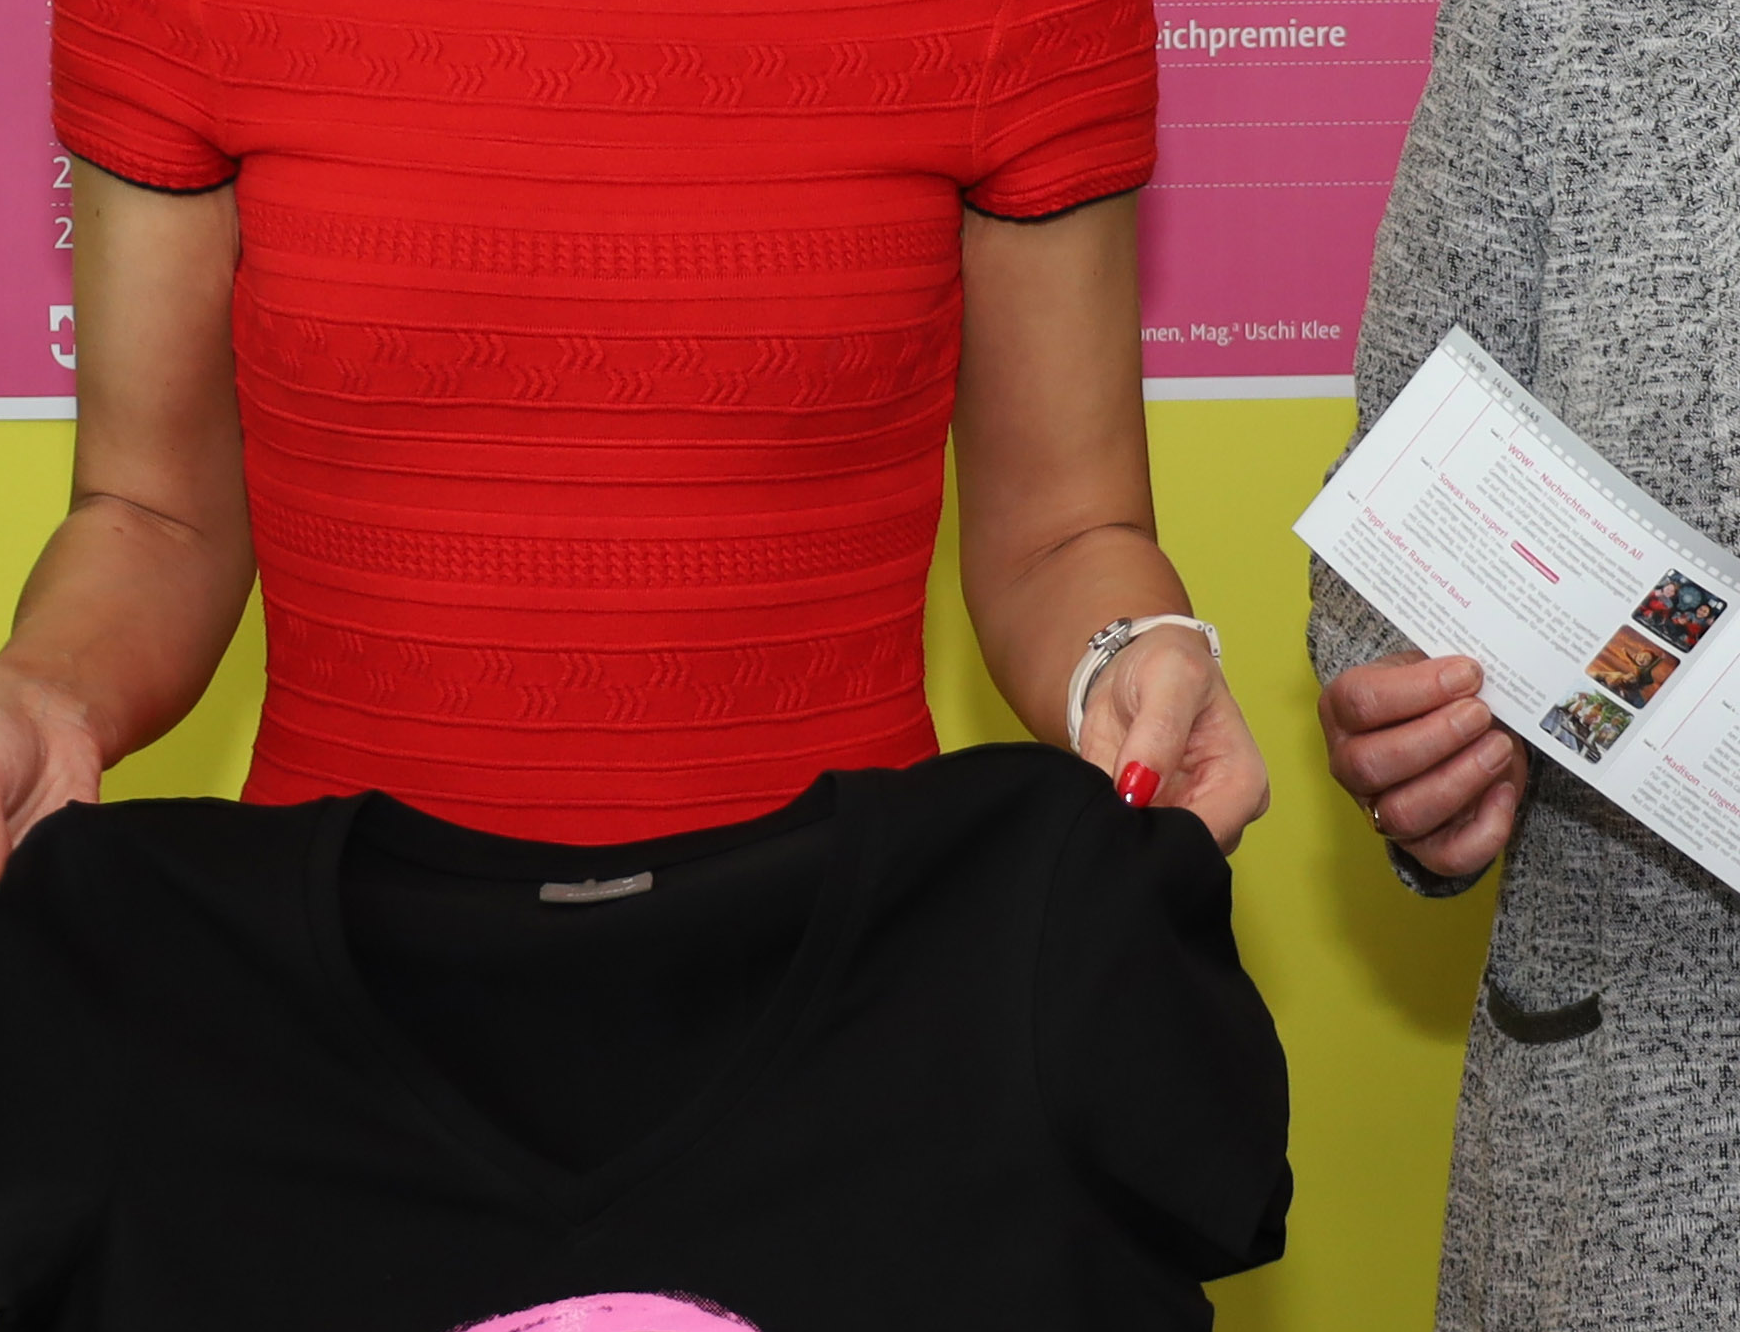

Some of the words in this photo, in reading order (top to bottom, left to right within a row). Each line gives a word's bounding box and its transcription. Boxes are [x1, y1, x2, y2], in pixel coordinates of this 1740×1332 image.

[1245, 320, 1295, 340] Uschi
[1301, 320, 1340, 340] Klee
[1438, 472, 1464, 499] Sowas
[1464, 497, 1481, 515] von
[1481, 512, 1509, 538] super!
[1508, 444, 1535, 469] WOW!
[1540, 472, 1592, 520] Nachrichten
[1591, 516, 1608, 534] aus
[1608, 532, 1630, 551] dem
[1628, 548, 1644, 561] All
[1362, 506, 1385, 529] Pippi
[1384, 525, 1409, 551] außer
[1408, 550, 1432, 573] Rand
[1430, 570, 1449, 589] und
[1447, 585, 1472, 609] Band
[1663, 754, 1701, 787] Madison
